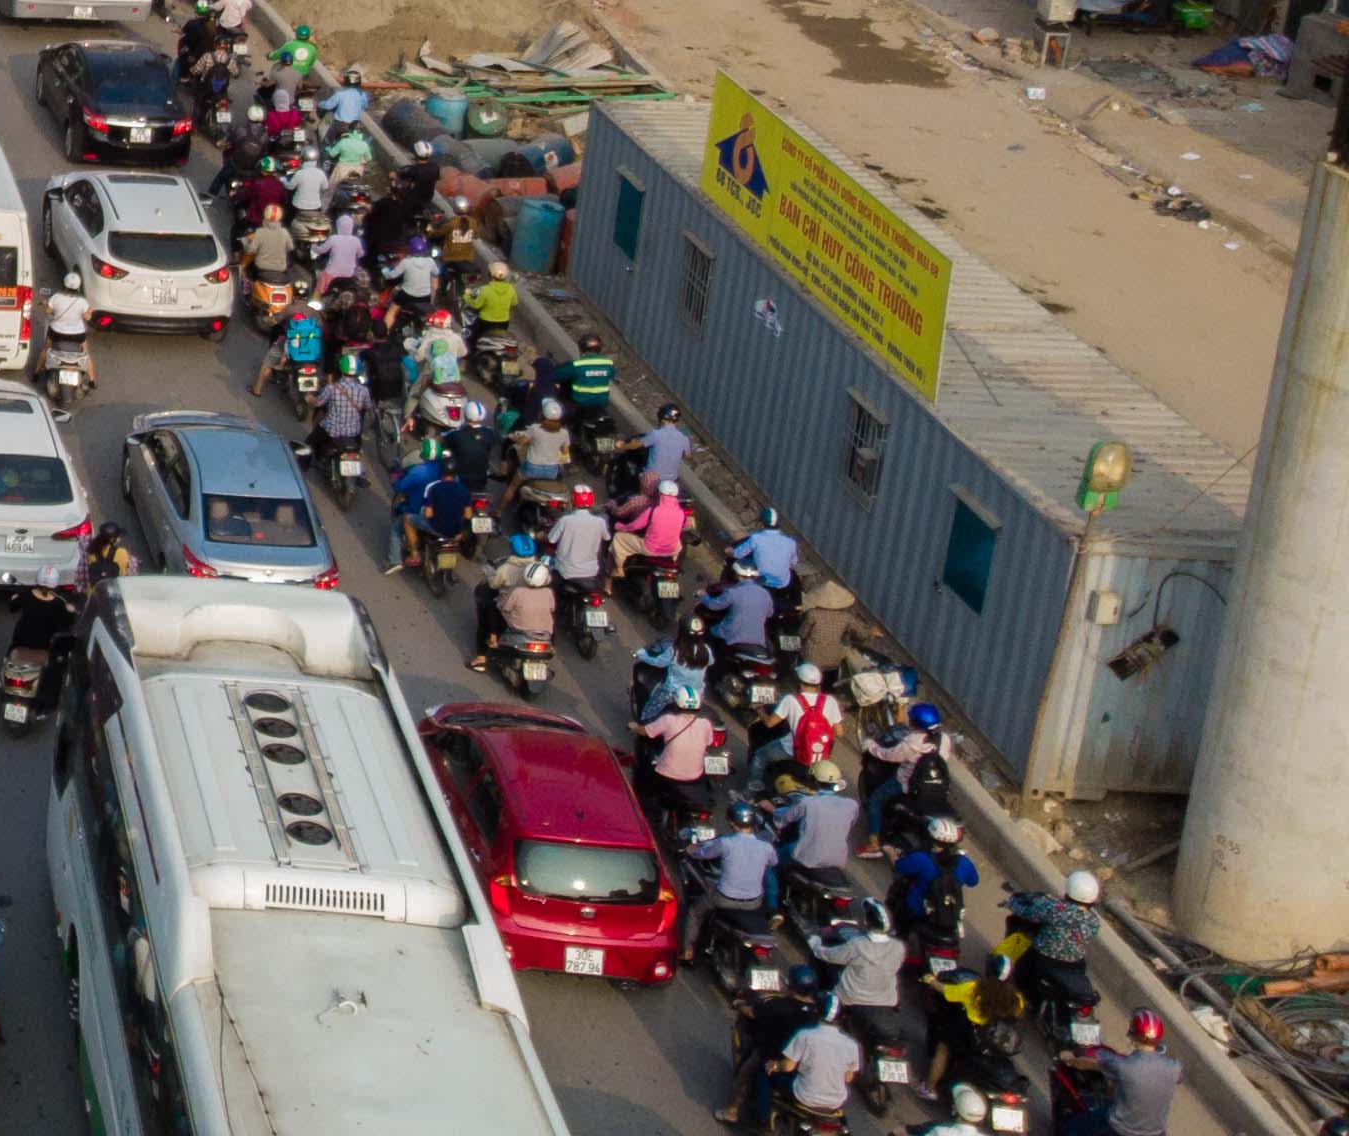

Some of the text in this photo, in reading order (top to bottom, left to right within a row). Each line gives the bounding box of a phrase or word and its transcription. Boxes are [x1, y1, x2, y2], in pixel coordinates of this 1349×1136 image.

[779, 191, 800, 229] BAN
[821, 227, 843, 267] HUY
[844, 244, 875, 295] CÔNG
[574, 949, 594, 961] 30E
[566, 960, 601, 974] 787.94
